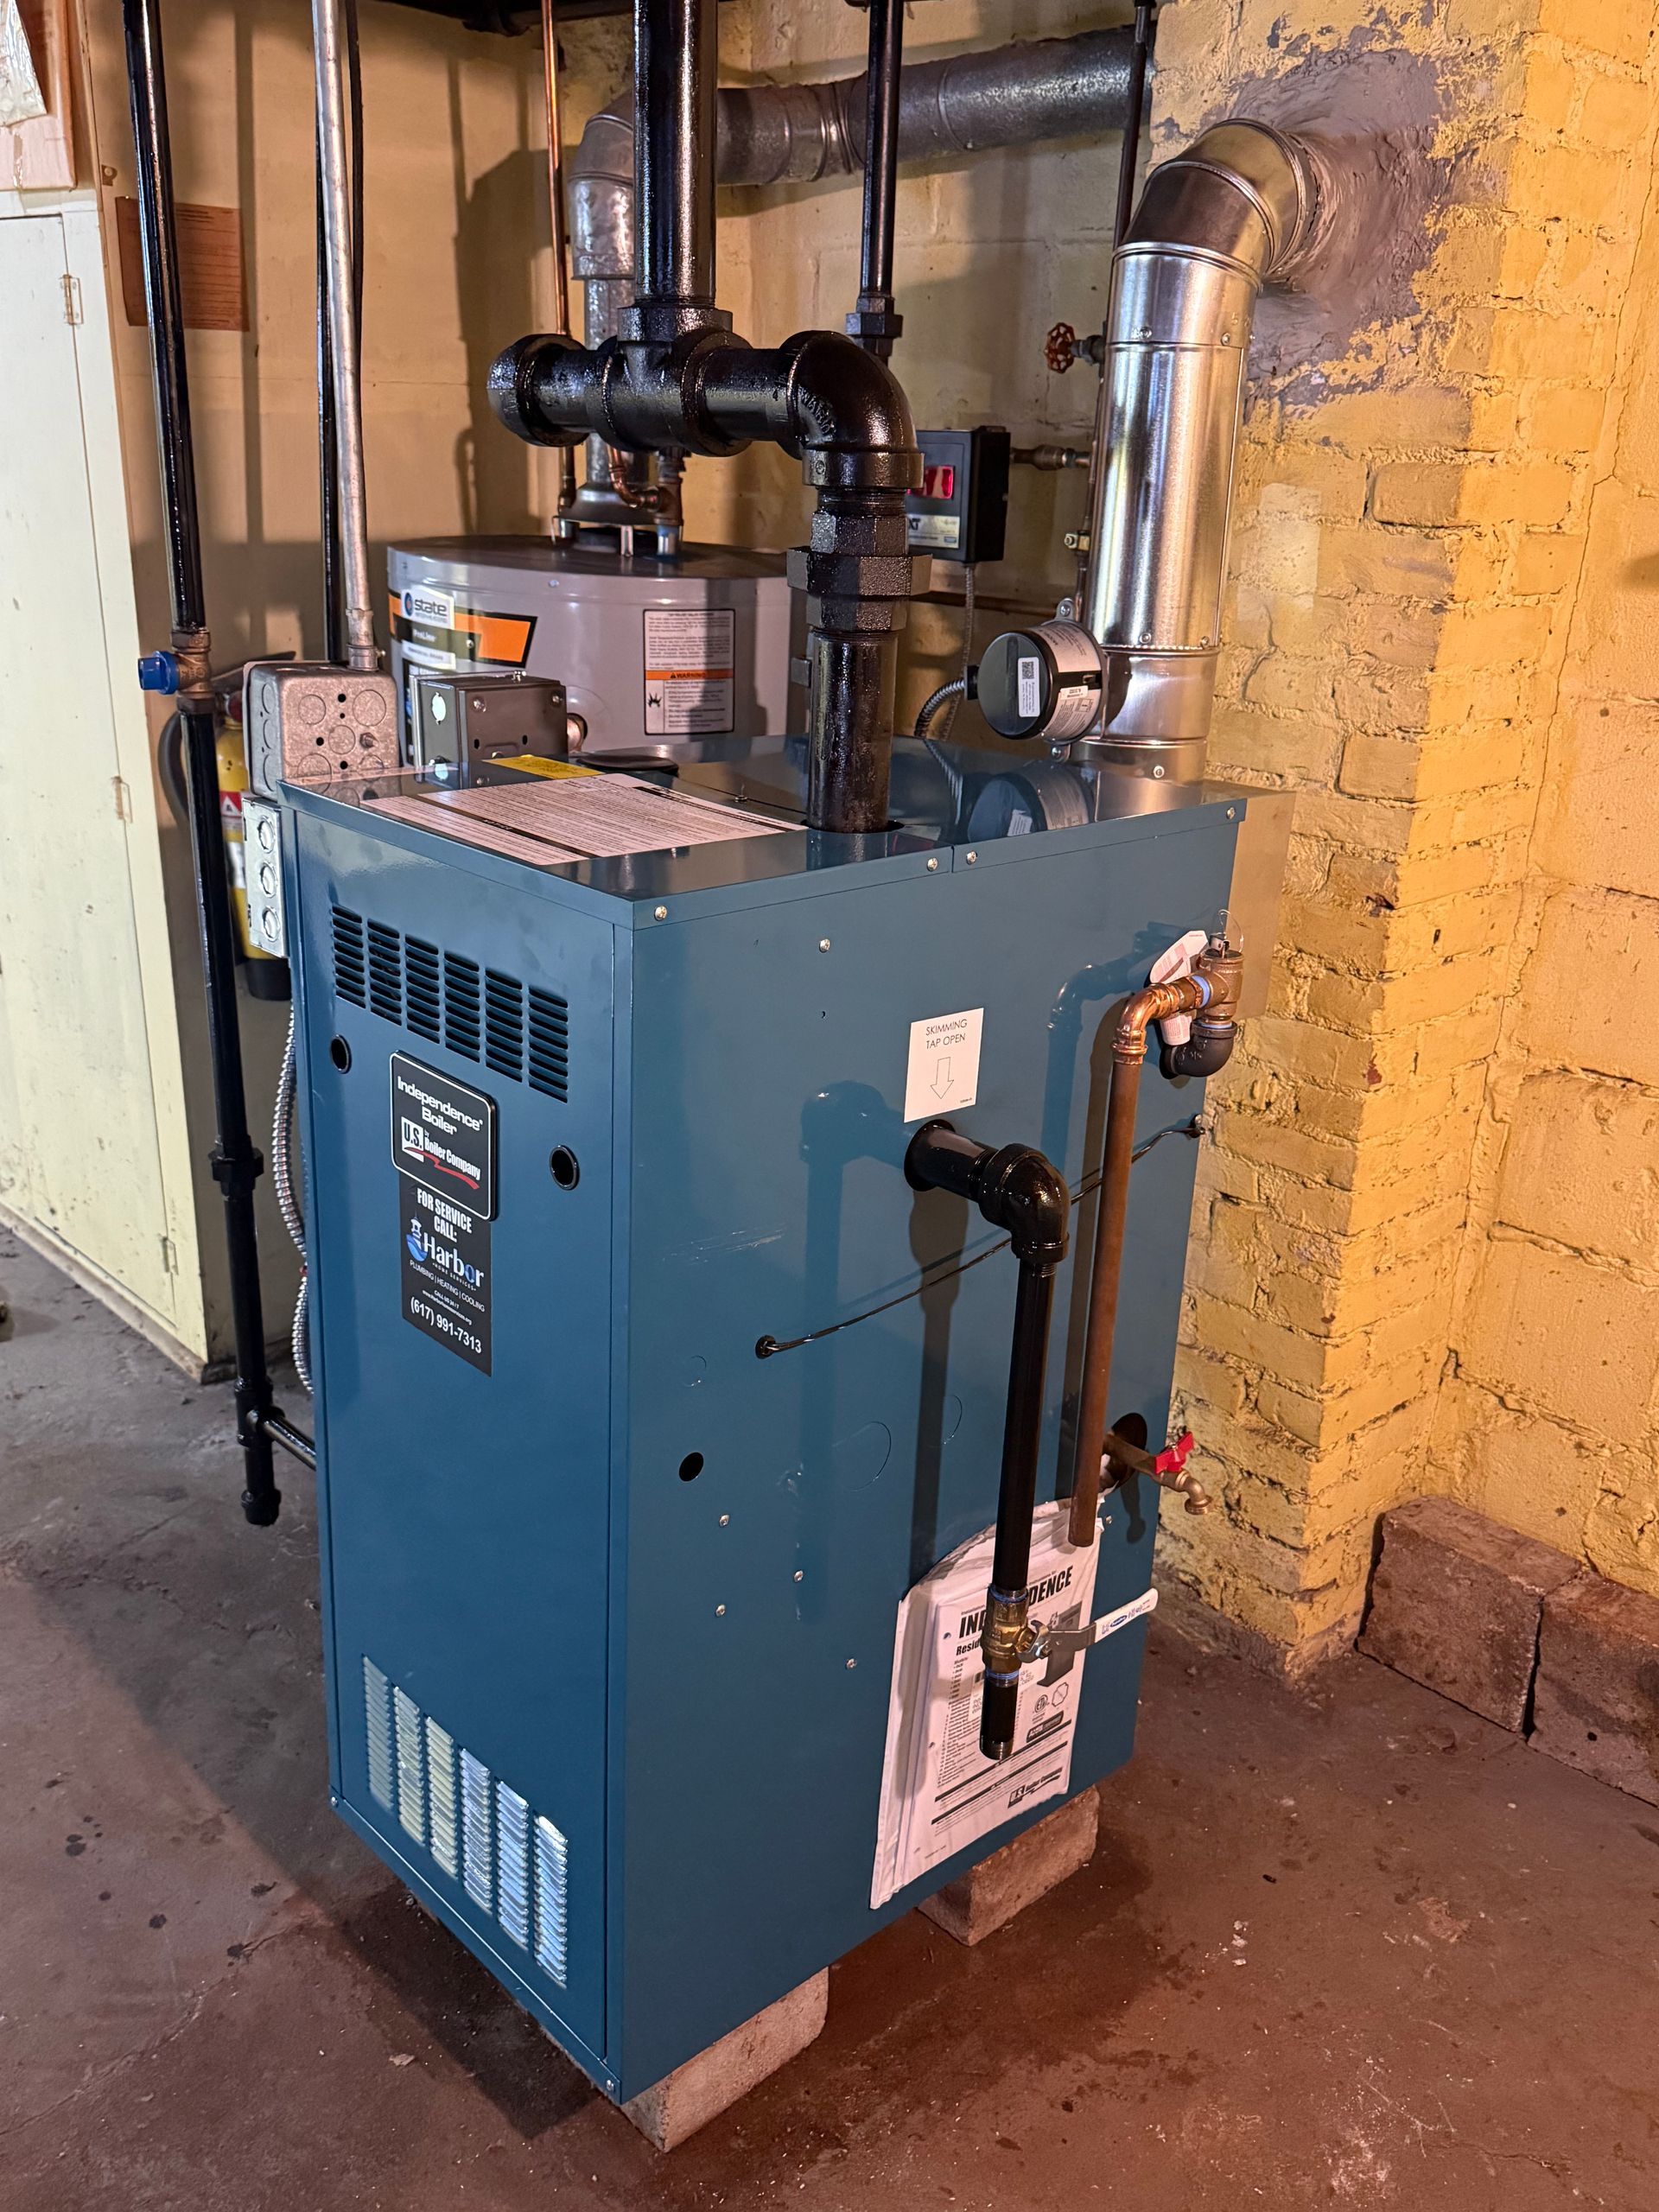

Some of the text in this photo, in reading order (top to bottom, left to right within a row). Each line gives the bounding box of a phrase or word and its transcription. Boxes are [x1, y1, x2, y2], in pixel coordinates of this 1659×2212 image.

[415, 599, 448, 617] state
[925, 1019, 968, 1036] SKIMMING
[926, 1033, 966, 1049] TAP OPEN
[422, 1106, 457, 1135] Boiler
[404, 1122, 481, 1180] U.S. Boiler Company
[417, 1187, 473, 1234] FOR SERVICE
[434, 1215, 457, 1243] CALL:
[423, 1232, 484, 1287] Harbor
[410, 1259, 485, 1313] PLUMBING HEATING COOLING
[434, 1290, 443, 1300] CALL
[410, 1296, 482, 1354] (617) 991-7313
